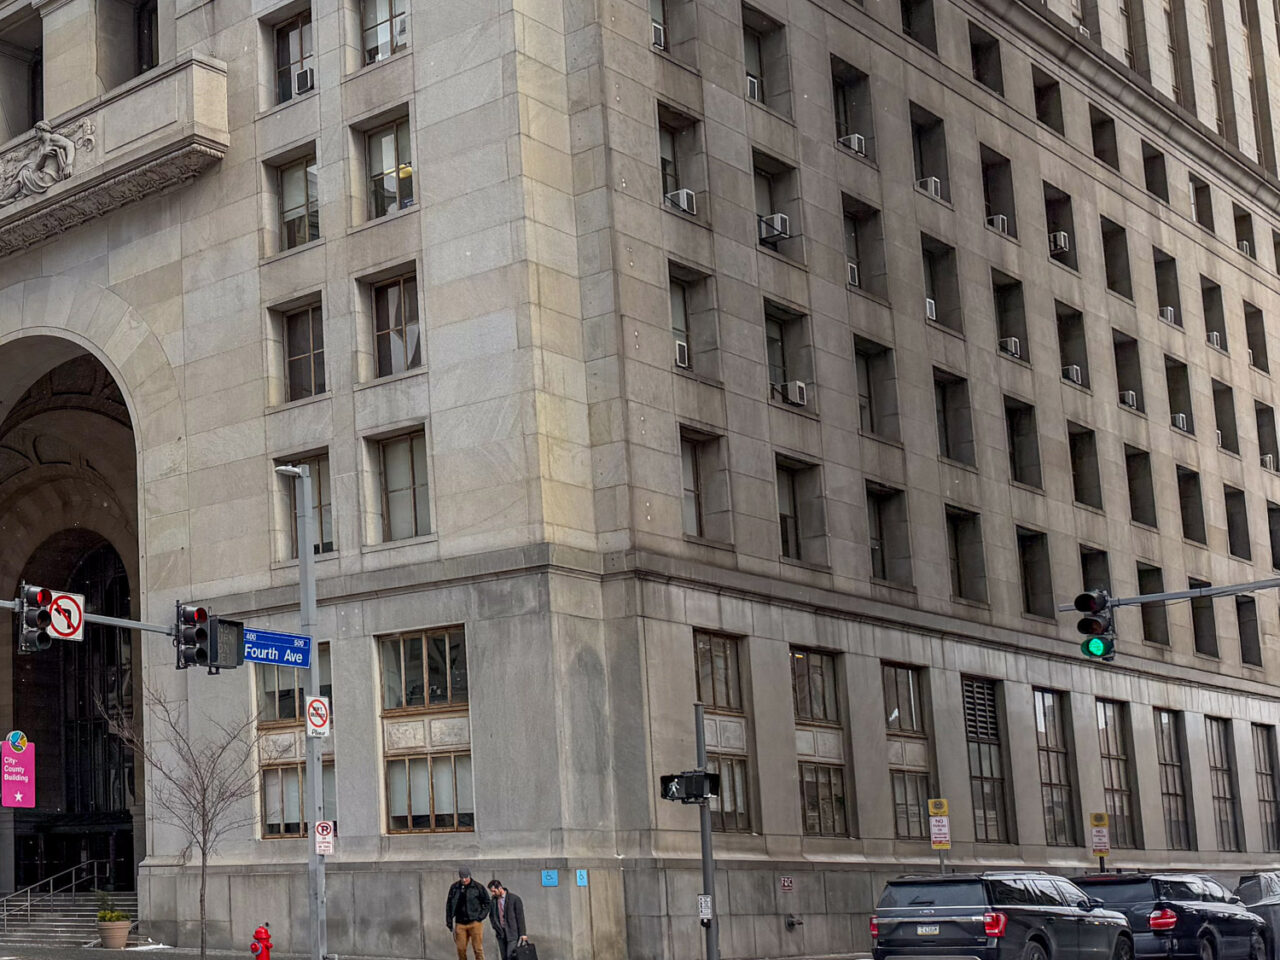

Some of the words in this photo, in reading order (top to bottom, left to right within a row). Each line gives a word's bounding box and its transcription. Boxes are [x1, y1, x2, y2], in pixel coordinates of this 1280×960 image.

[245, 632, 257, 641] 400
[293, 639, 305, 648] 500
[244, 643, 279, 660] Fourth
[283, 648, 303, 663] Ave
[3, 765, 25, 774] County
[3, 773, 29, 784] Building
